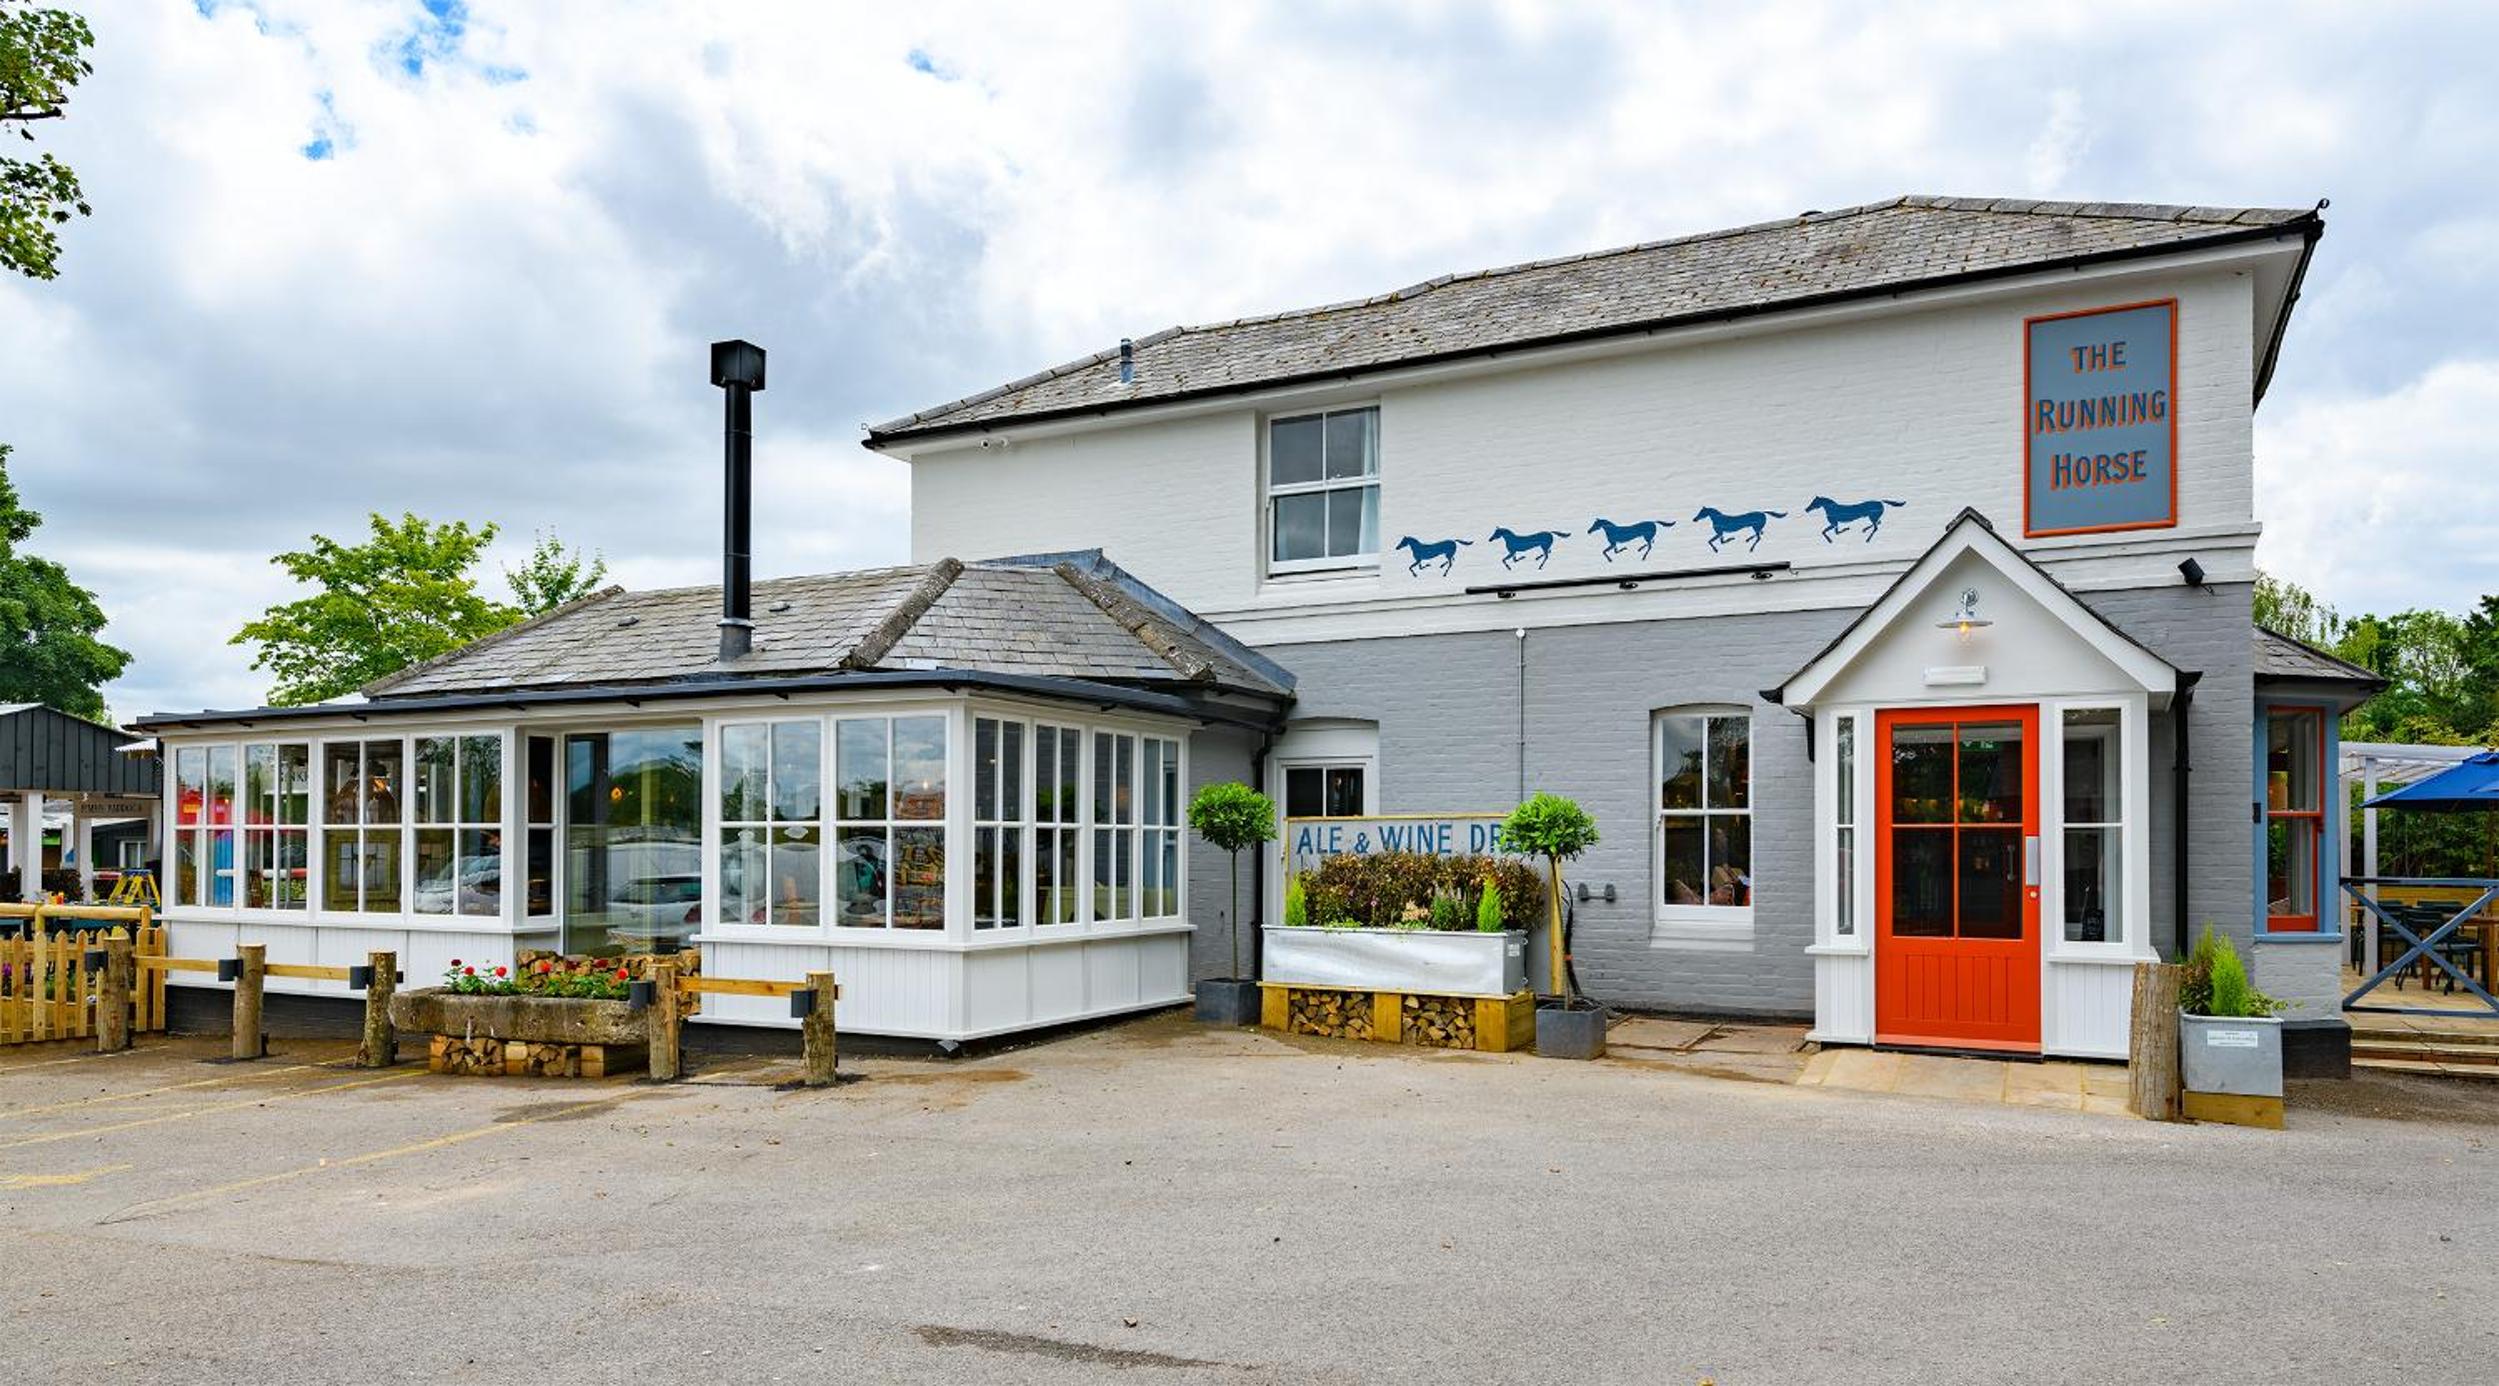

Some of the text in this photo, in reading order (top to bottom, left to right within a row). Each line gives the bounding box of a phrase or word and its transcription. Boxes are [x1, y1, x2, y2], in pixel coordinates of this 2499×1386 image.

[2071, 341, 2127, 374] THE
[2034, 390, 2166, 434] RUNNING
[2051, 450, 2148, 491] HORSE
[1296, 826, 1342, 854] ALE
[1354, 832, 1370, 853] &
[1378, 824, 1452, 853] WINE
